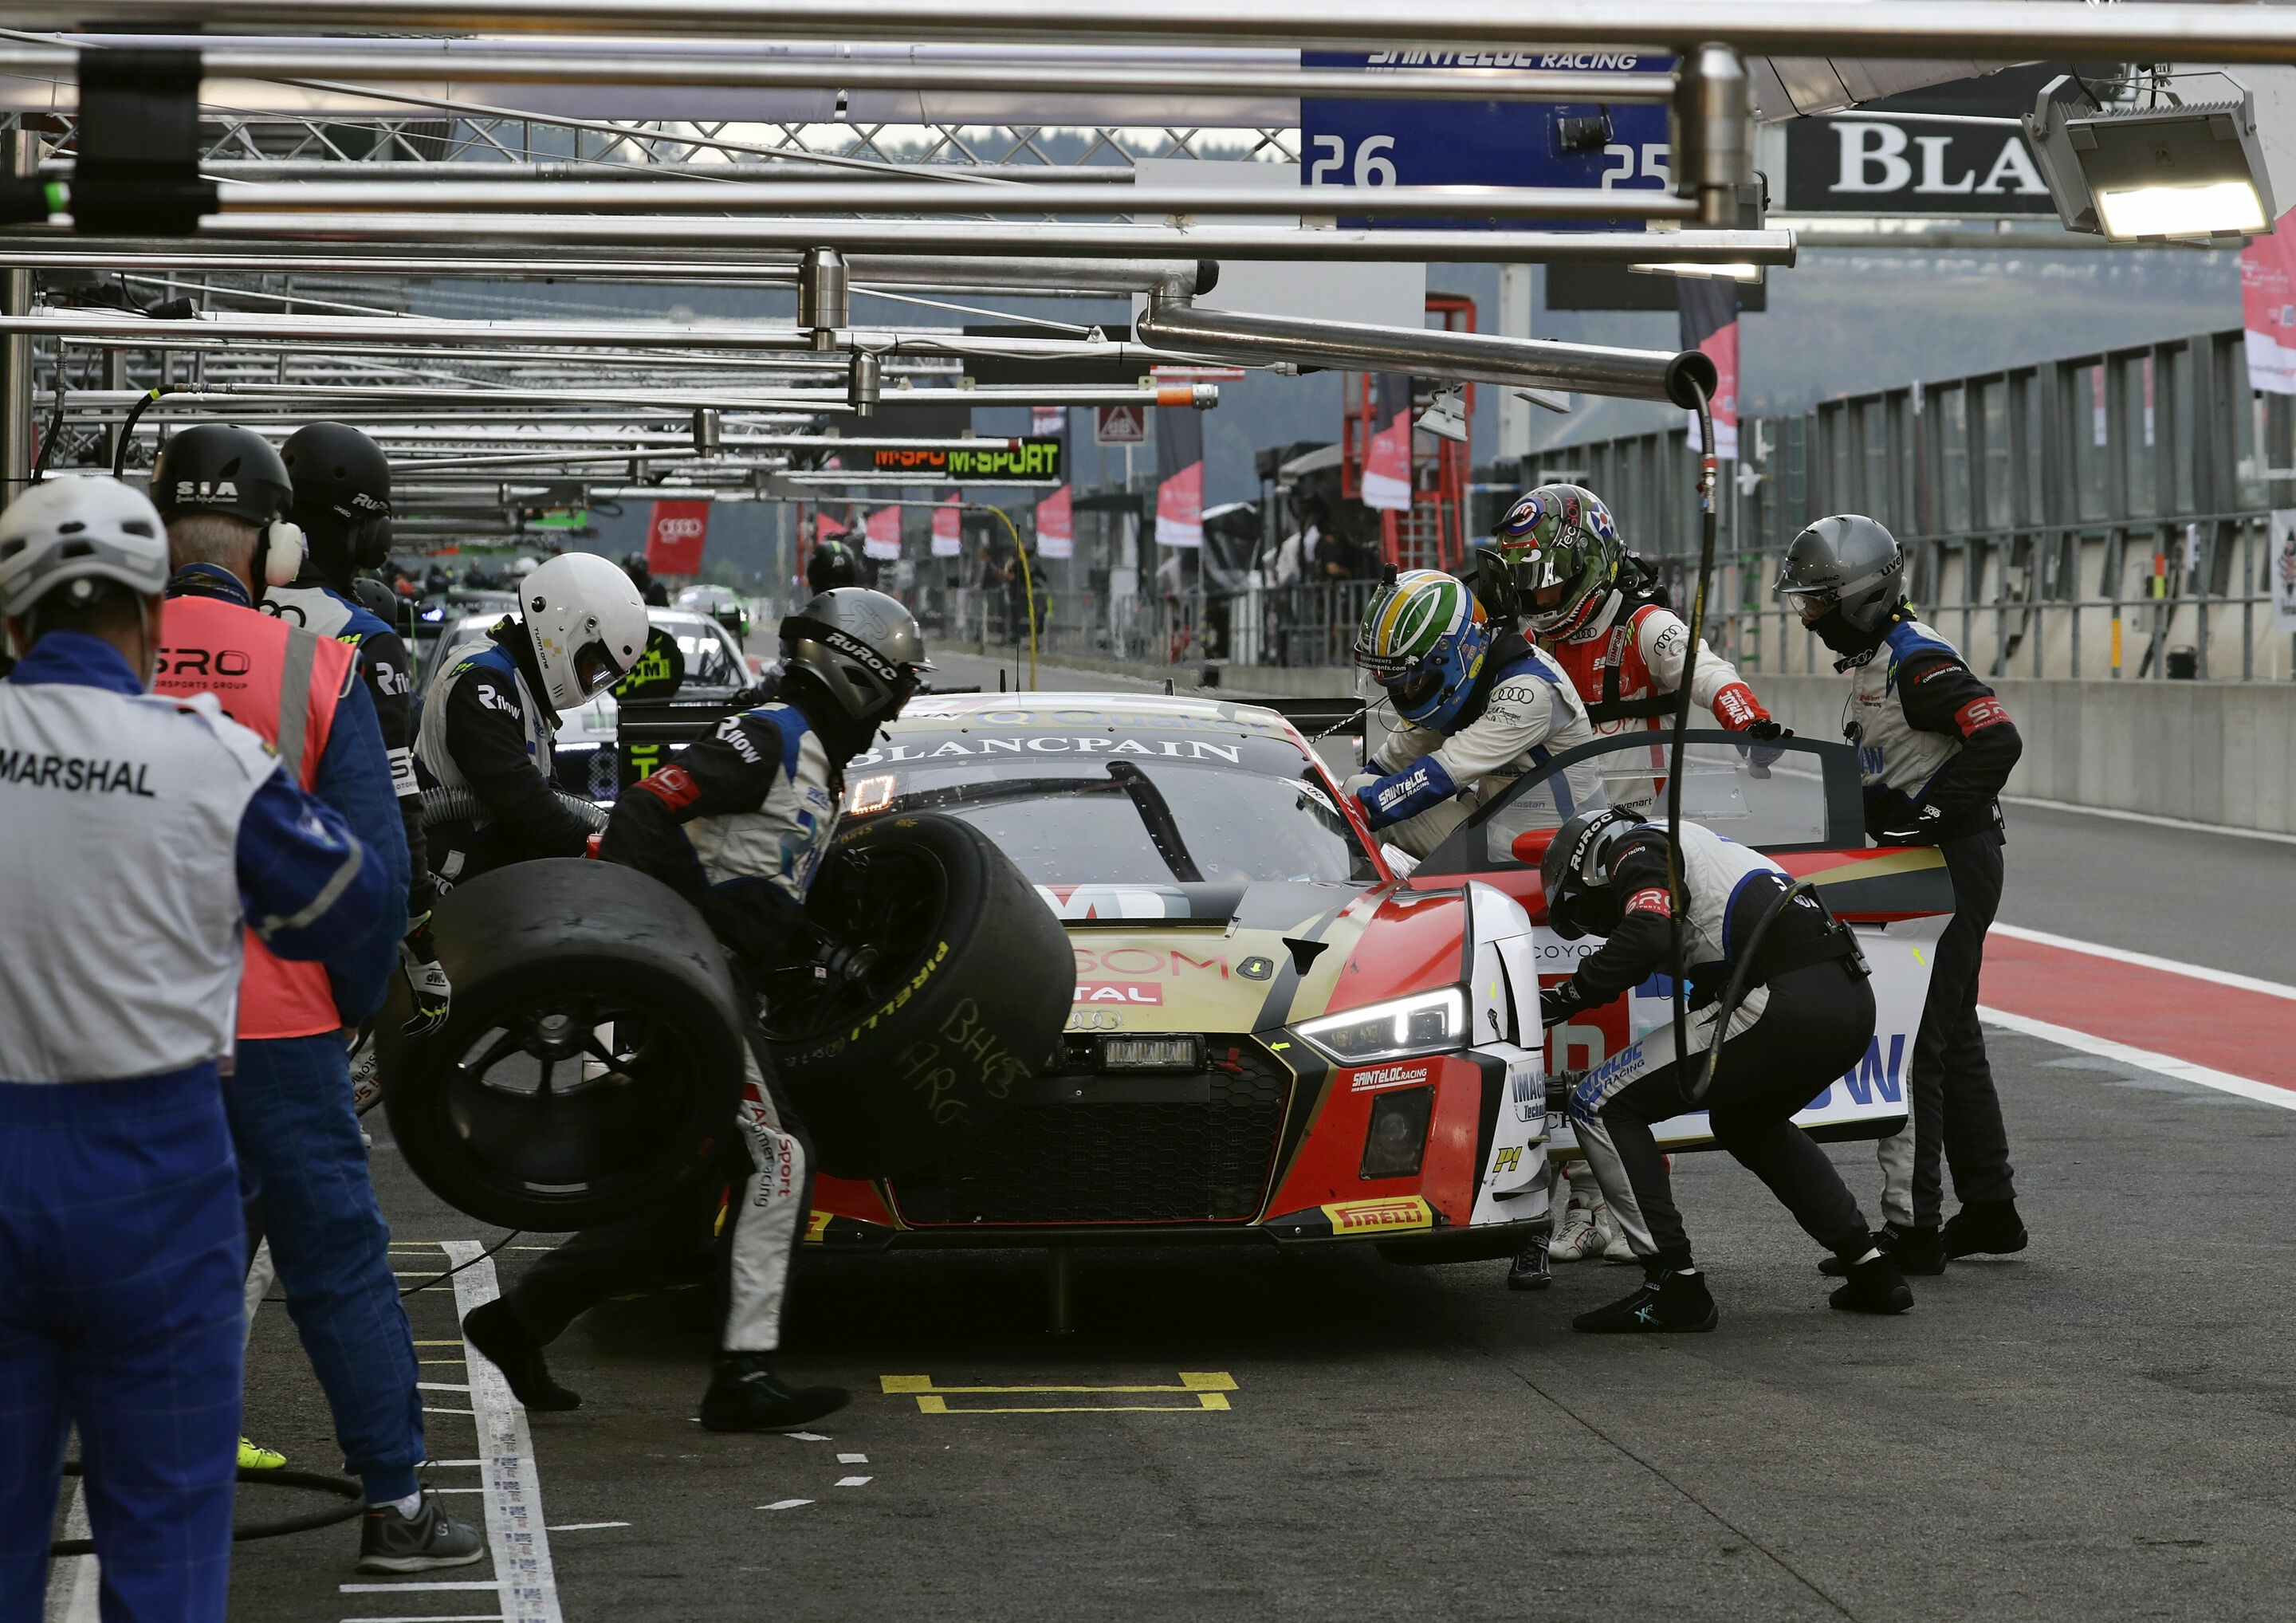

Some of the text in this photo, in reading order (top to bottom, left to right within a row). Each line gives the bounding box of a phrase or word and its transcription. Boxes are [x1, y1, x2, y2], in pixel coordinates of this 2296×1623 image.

[1541, 52, 1637, 70] RACING
[1311, 135, 1397, 187] 26
[1602, 143, 1670, 191] 25
[1828, 122, 2051, 195] BLA
[176, 481, 238, 496] SIA
[1610, 629, 1623, 662] SIMPSON
[477, 684, 521, 720] Rflow
[0, 749, 155, 797] MARSHAL
[1407, 781, 1430, 797] RACING
[1074, 948, 1229, 980] SOM
[851, 941, 949, 1041] PIRELLI
[1074, 986, 1158, 1003] TAL
[1401, 1068, 1427, 1080] RACING
[1604, 1059, 1645, 1090] RACING
[778, 1138, 794, 1197] Sport
[1335, 1202, 1423, 1228] PIRELLI
